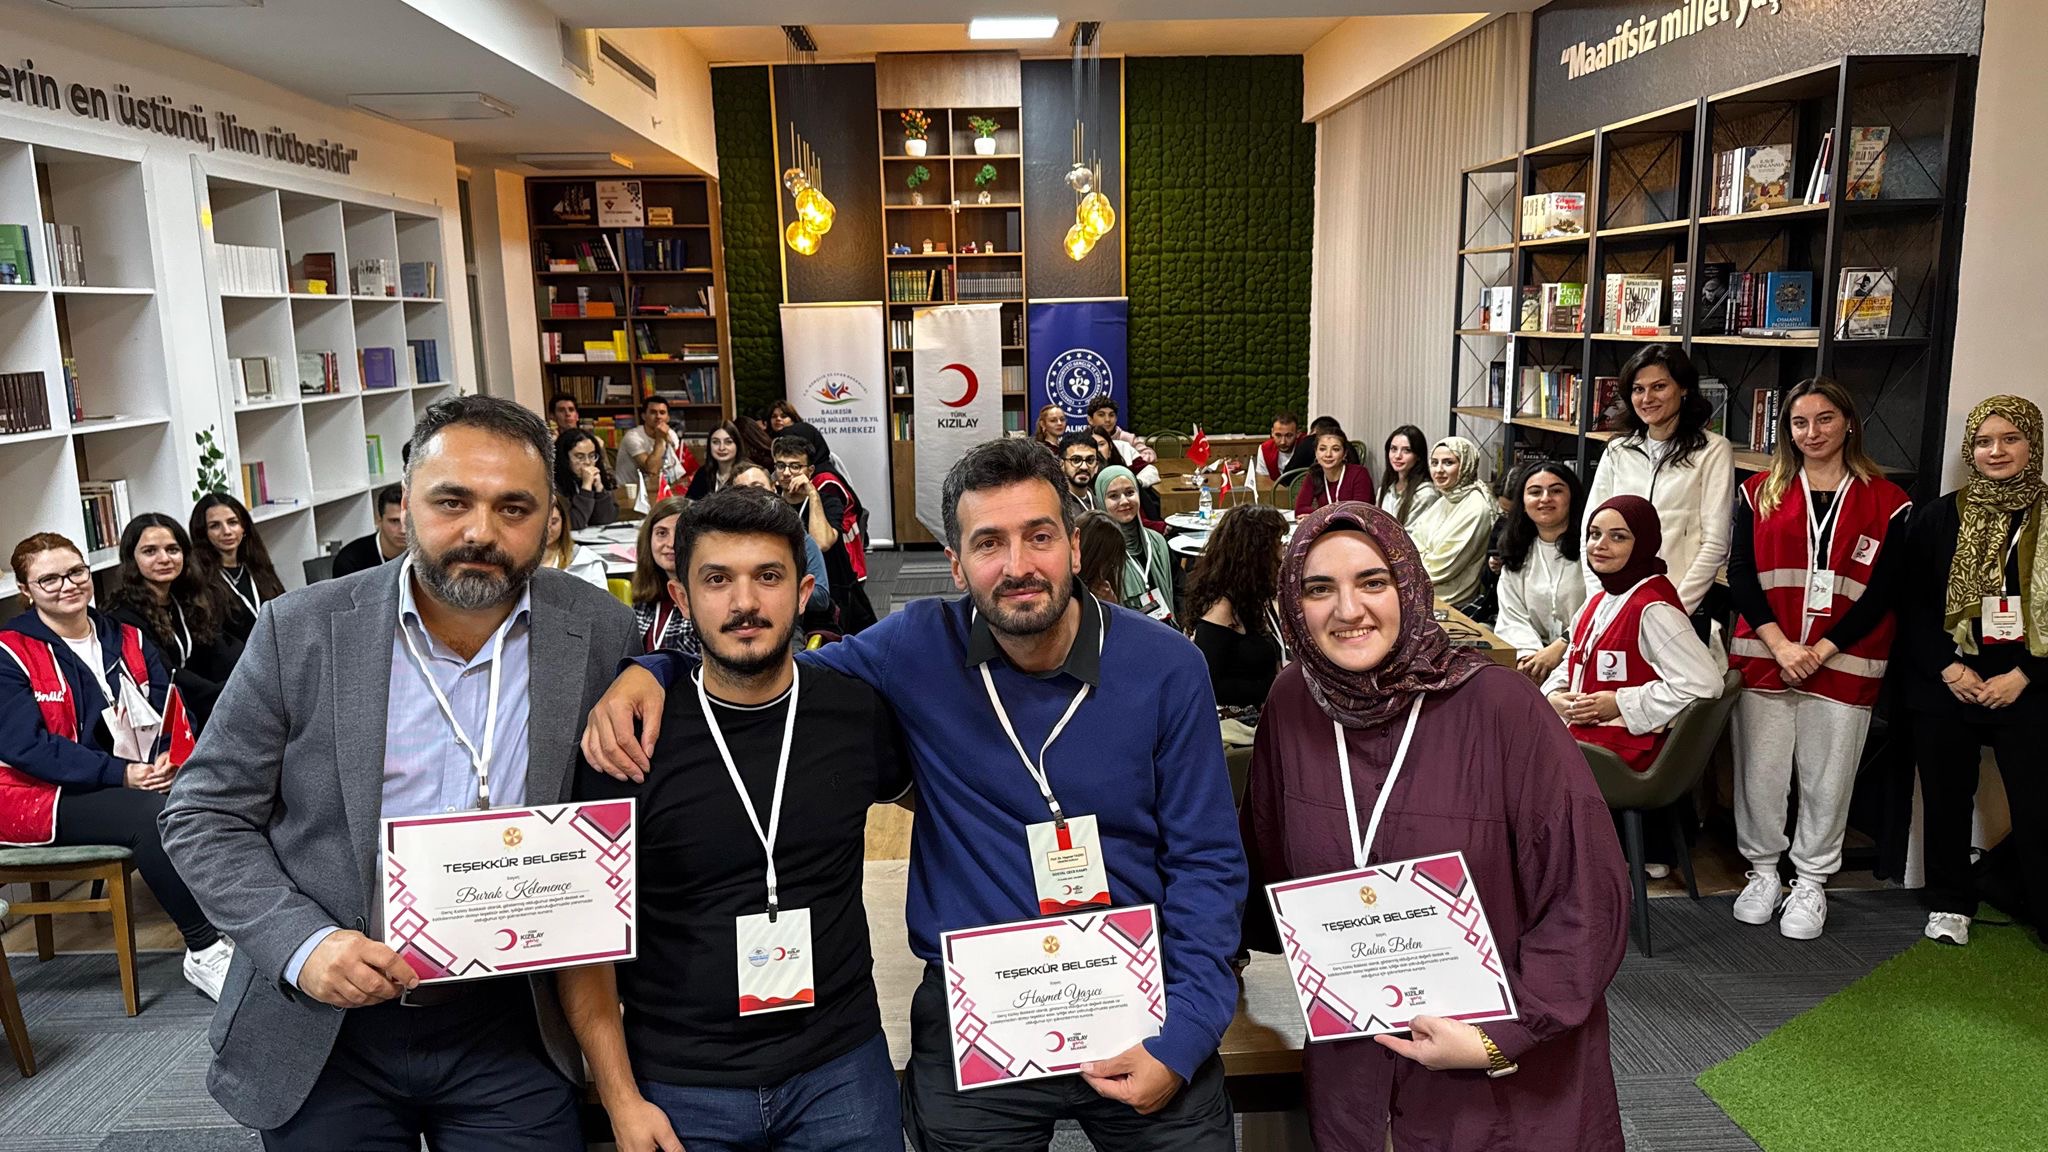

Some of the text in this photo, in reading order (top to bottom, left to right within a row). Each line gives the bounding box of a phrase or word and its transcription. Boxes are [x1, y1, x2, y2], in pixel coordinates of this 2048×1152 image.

[1660, 0, 1731, 46] millet
[67, 83, 110, 121] en
[114, 84, 215, 152] üstünü,
[216, 111, 260, 155] ilim
[1560, 285, 1581, 295] derv
[803, 417, 826, 425] LEŞMİŞ
[821, 408, 852, 416] BALIKESİR
[938, 418, 979, 428] KIZILAY
[1065, 425, 1090, 433] ALIKE
[443, 848, 587, 873] TEŞEKKÜR BELGESİ
[456, 878, 572, 903] Burak Kelemençe
[1322, 905, 1438, 932] TEŞEKKÜR BELGESİ
[1350, 936, 1423, 959] Rabia Belen
[995, 955, 1118, 980] TEŞEKKÜR BELGESİ
[1012, 989, 1062, 1009] Haşmet
[1064, 983, 1102, 1006] Yazıcı
